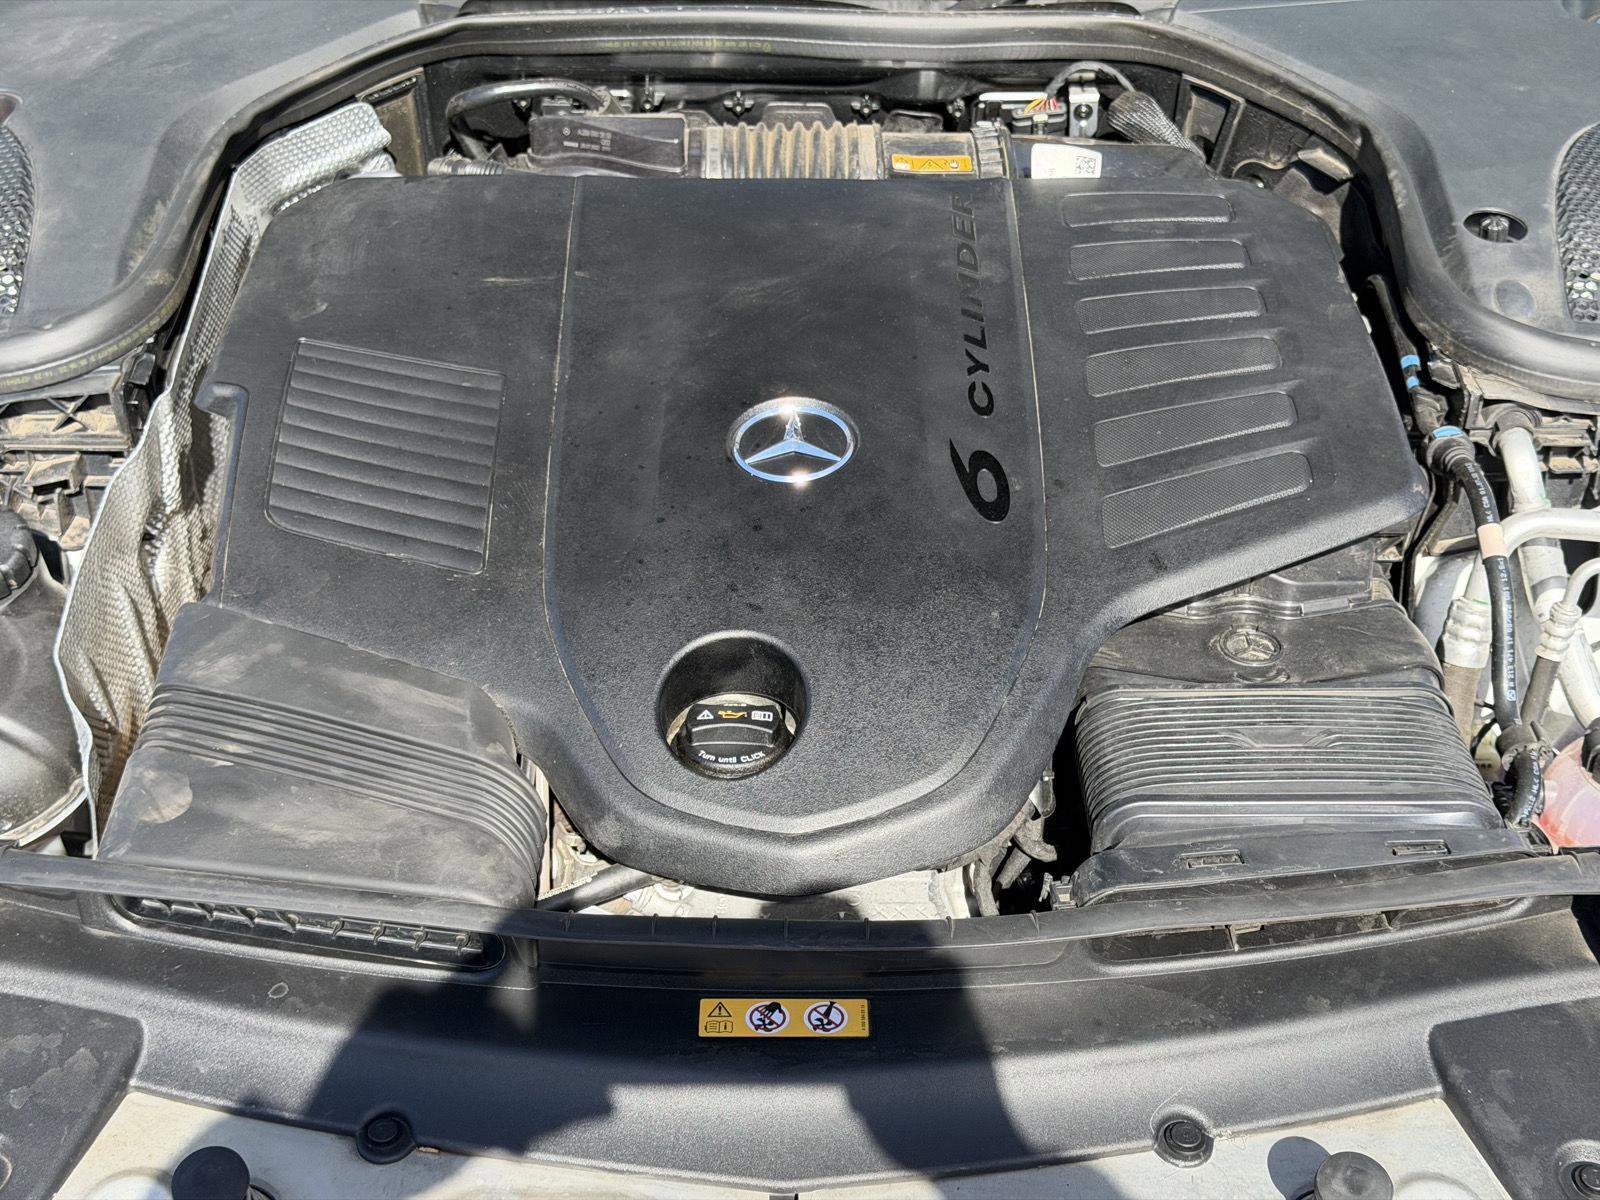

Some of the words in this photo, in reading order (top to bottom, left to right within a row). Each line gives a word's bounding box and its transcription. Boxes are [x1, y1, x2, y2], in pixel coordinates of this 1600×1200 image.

[949, 191, 995, 418] CYLINDER
[949, 437, 1011, 523] 6
[697, 749, 716, 762] Turn
[718, 755, 737, 763] until
[740, 751, 766, 763] CLICK
